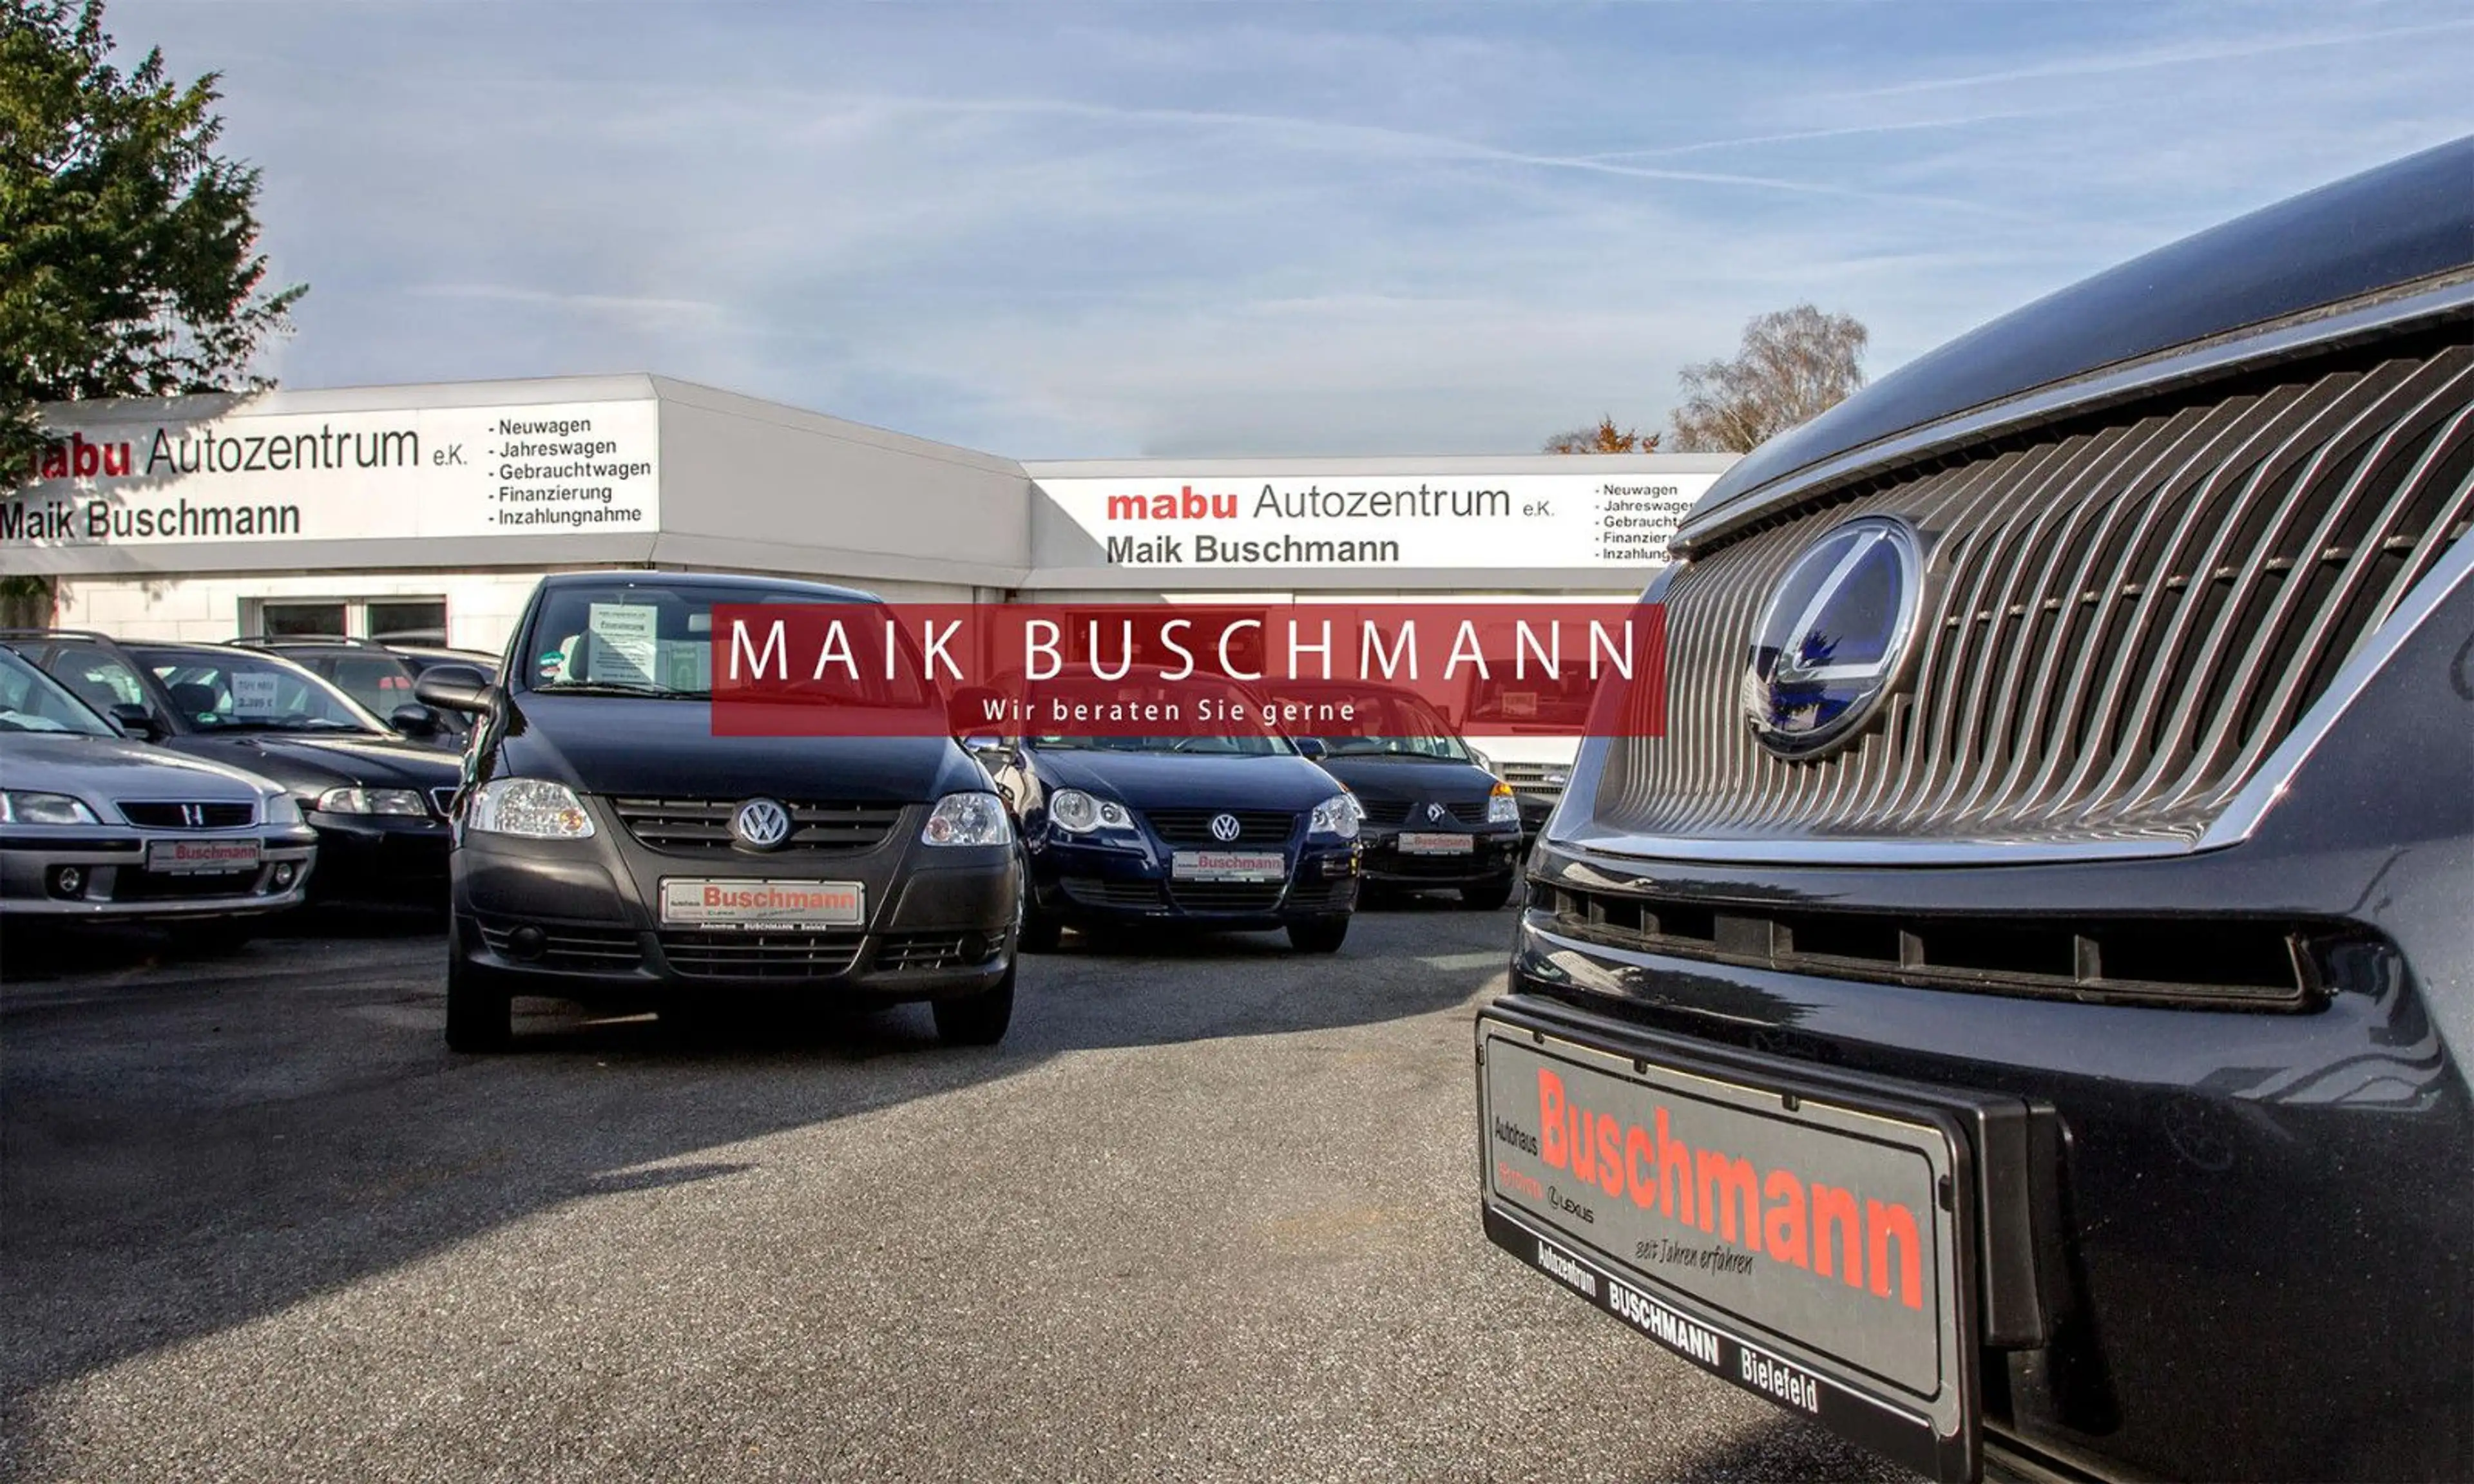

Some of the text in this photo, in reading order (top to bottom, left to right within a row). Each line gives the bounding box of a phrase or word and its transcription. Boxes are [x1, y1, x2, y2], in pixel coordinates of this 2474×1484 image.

[498, 418, 591, 437] Neuwagen
[29, 423, 468, 479] abu Autozentrum e.K.
[499, 439, 617, 458] Jahreswagen
[499, 461, 651, 480] Gebrauchtwagen
[499, 485, 613, 504] Finanzierung
[1603, 484, 1678, 499] Neuwagen
[1108, 483, 1555, 520] mabu Autozentrum e.K.
[0, 498, 300, 540] Maik Buschmann
[499, 507, 642, 526] Inzahlungnahme
[1603, 515, 1680, 528] Gebraucht
[1603, 531, 1671, 544] Finanzier
[1107, 534, 1399, 564] Maik Buschmann
[1603, 547, 1672, 562] Inzahlung
[176, 844, 256, 859] Buschmann
[1198, 855, 1281, 869] Buschmann
[703, 885, 856, 909] Buschmann
[1495, 1116, 1538, 1157] Autohaus
[1537, 1067, 1924, 1312] Buschmann
[1560, 1194, 1595, 1224] LEXUS
[1658, 1237, 1698, 1267] Jahren
[1700, 1244, 1754, 1277] erfahren
[1537, 1240, 1818, 1414] Autozentrum BUSCHMANN Bielefeld
